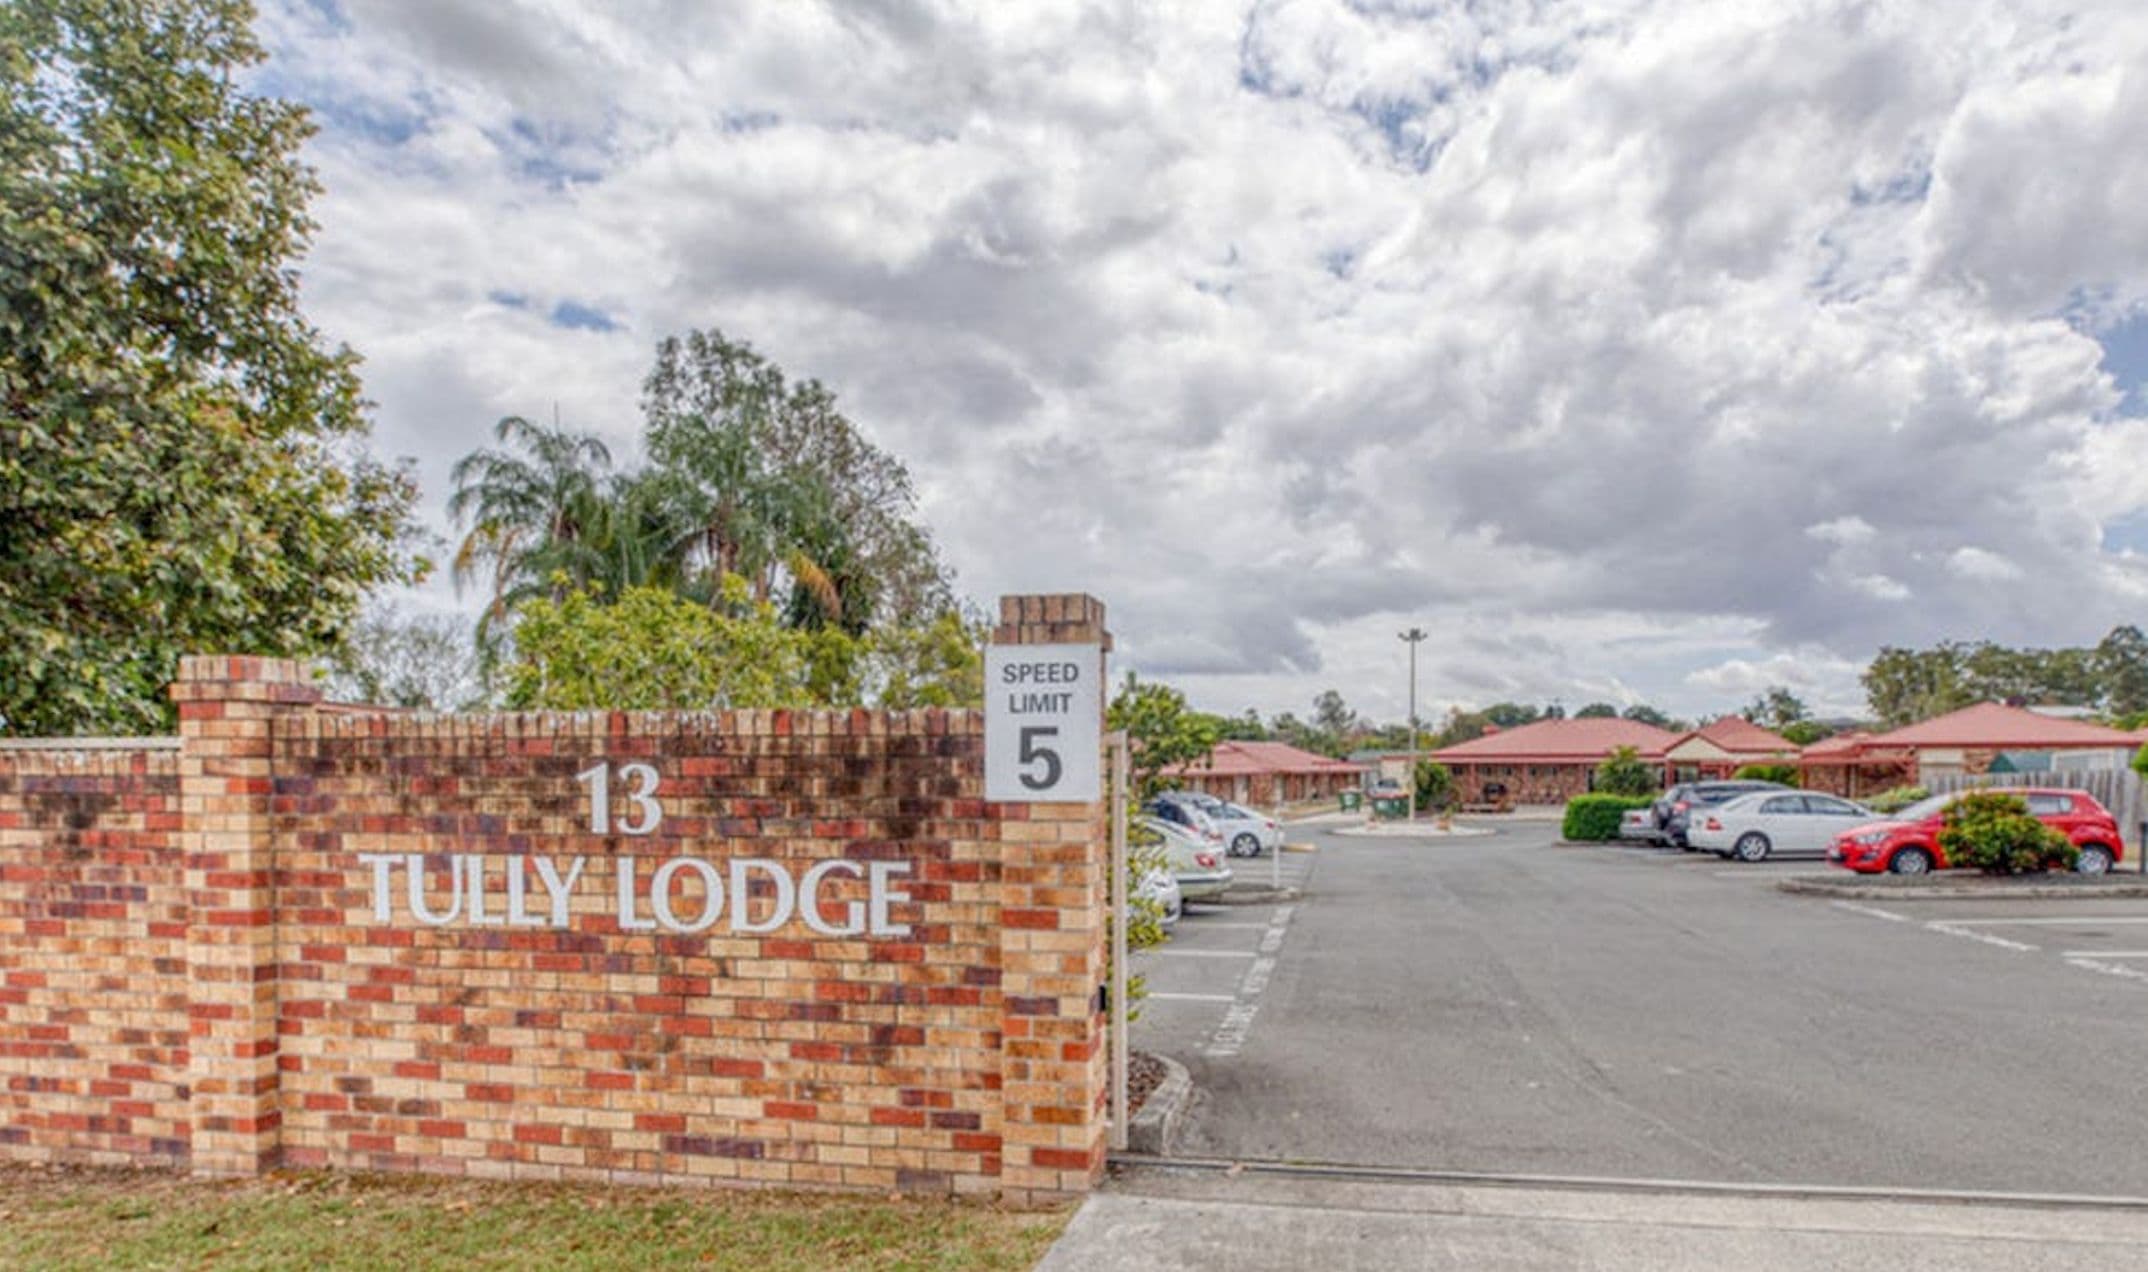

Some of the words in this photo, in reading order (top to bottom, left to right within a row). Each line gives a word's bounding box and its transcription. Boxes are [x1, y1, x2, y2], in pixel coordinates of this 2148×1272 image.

[1002, 663, 1080, 684] SPEED
[1009, 693, 1073, 714] LIMIT
[1018, 727, 1062, 791] 5
[575, 762, 663, 835] 13
[357, 853, 585, 929] TULLY
[616, 855, 913, 938] LODGE
